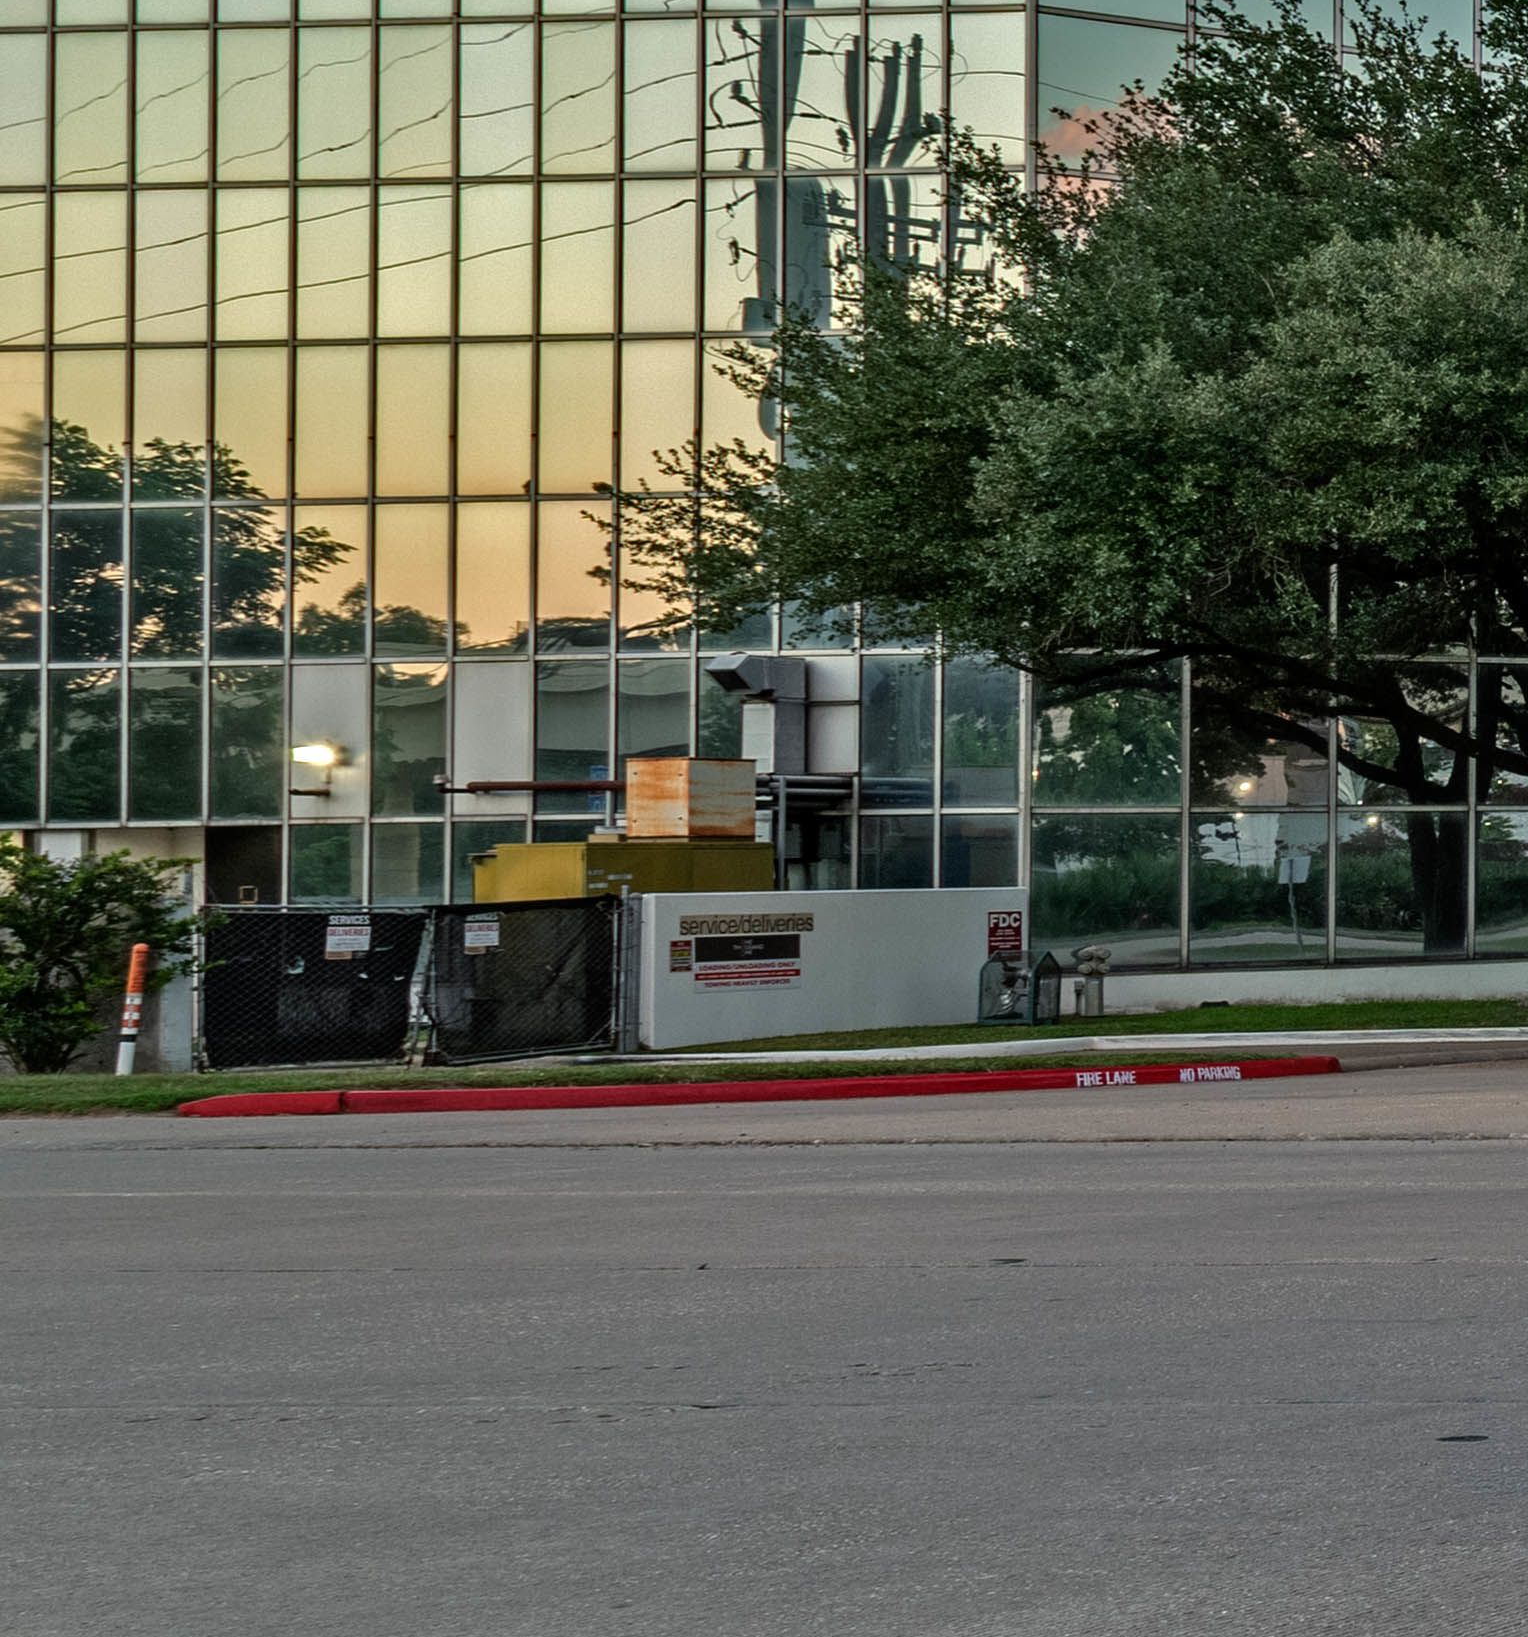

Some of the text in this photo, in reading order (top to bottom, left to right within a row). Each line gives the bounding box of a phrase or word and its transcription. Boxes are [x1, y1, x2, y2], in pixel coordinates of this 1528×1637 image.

[679, 914, 815, 936] service/deliveries
[990, 913, 1021, 928] FDC
[1076, 1066, 1242, 1087] FIRE LANE NO PARKING
